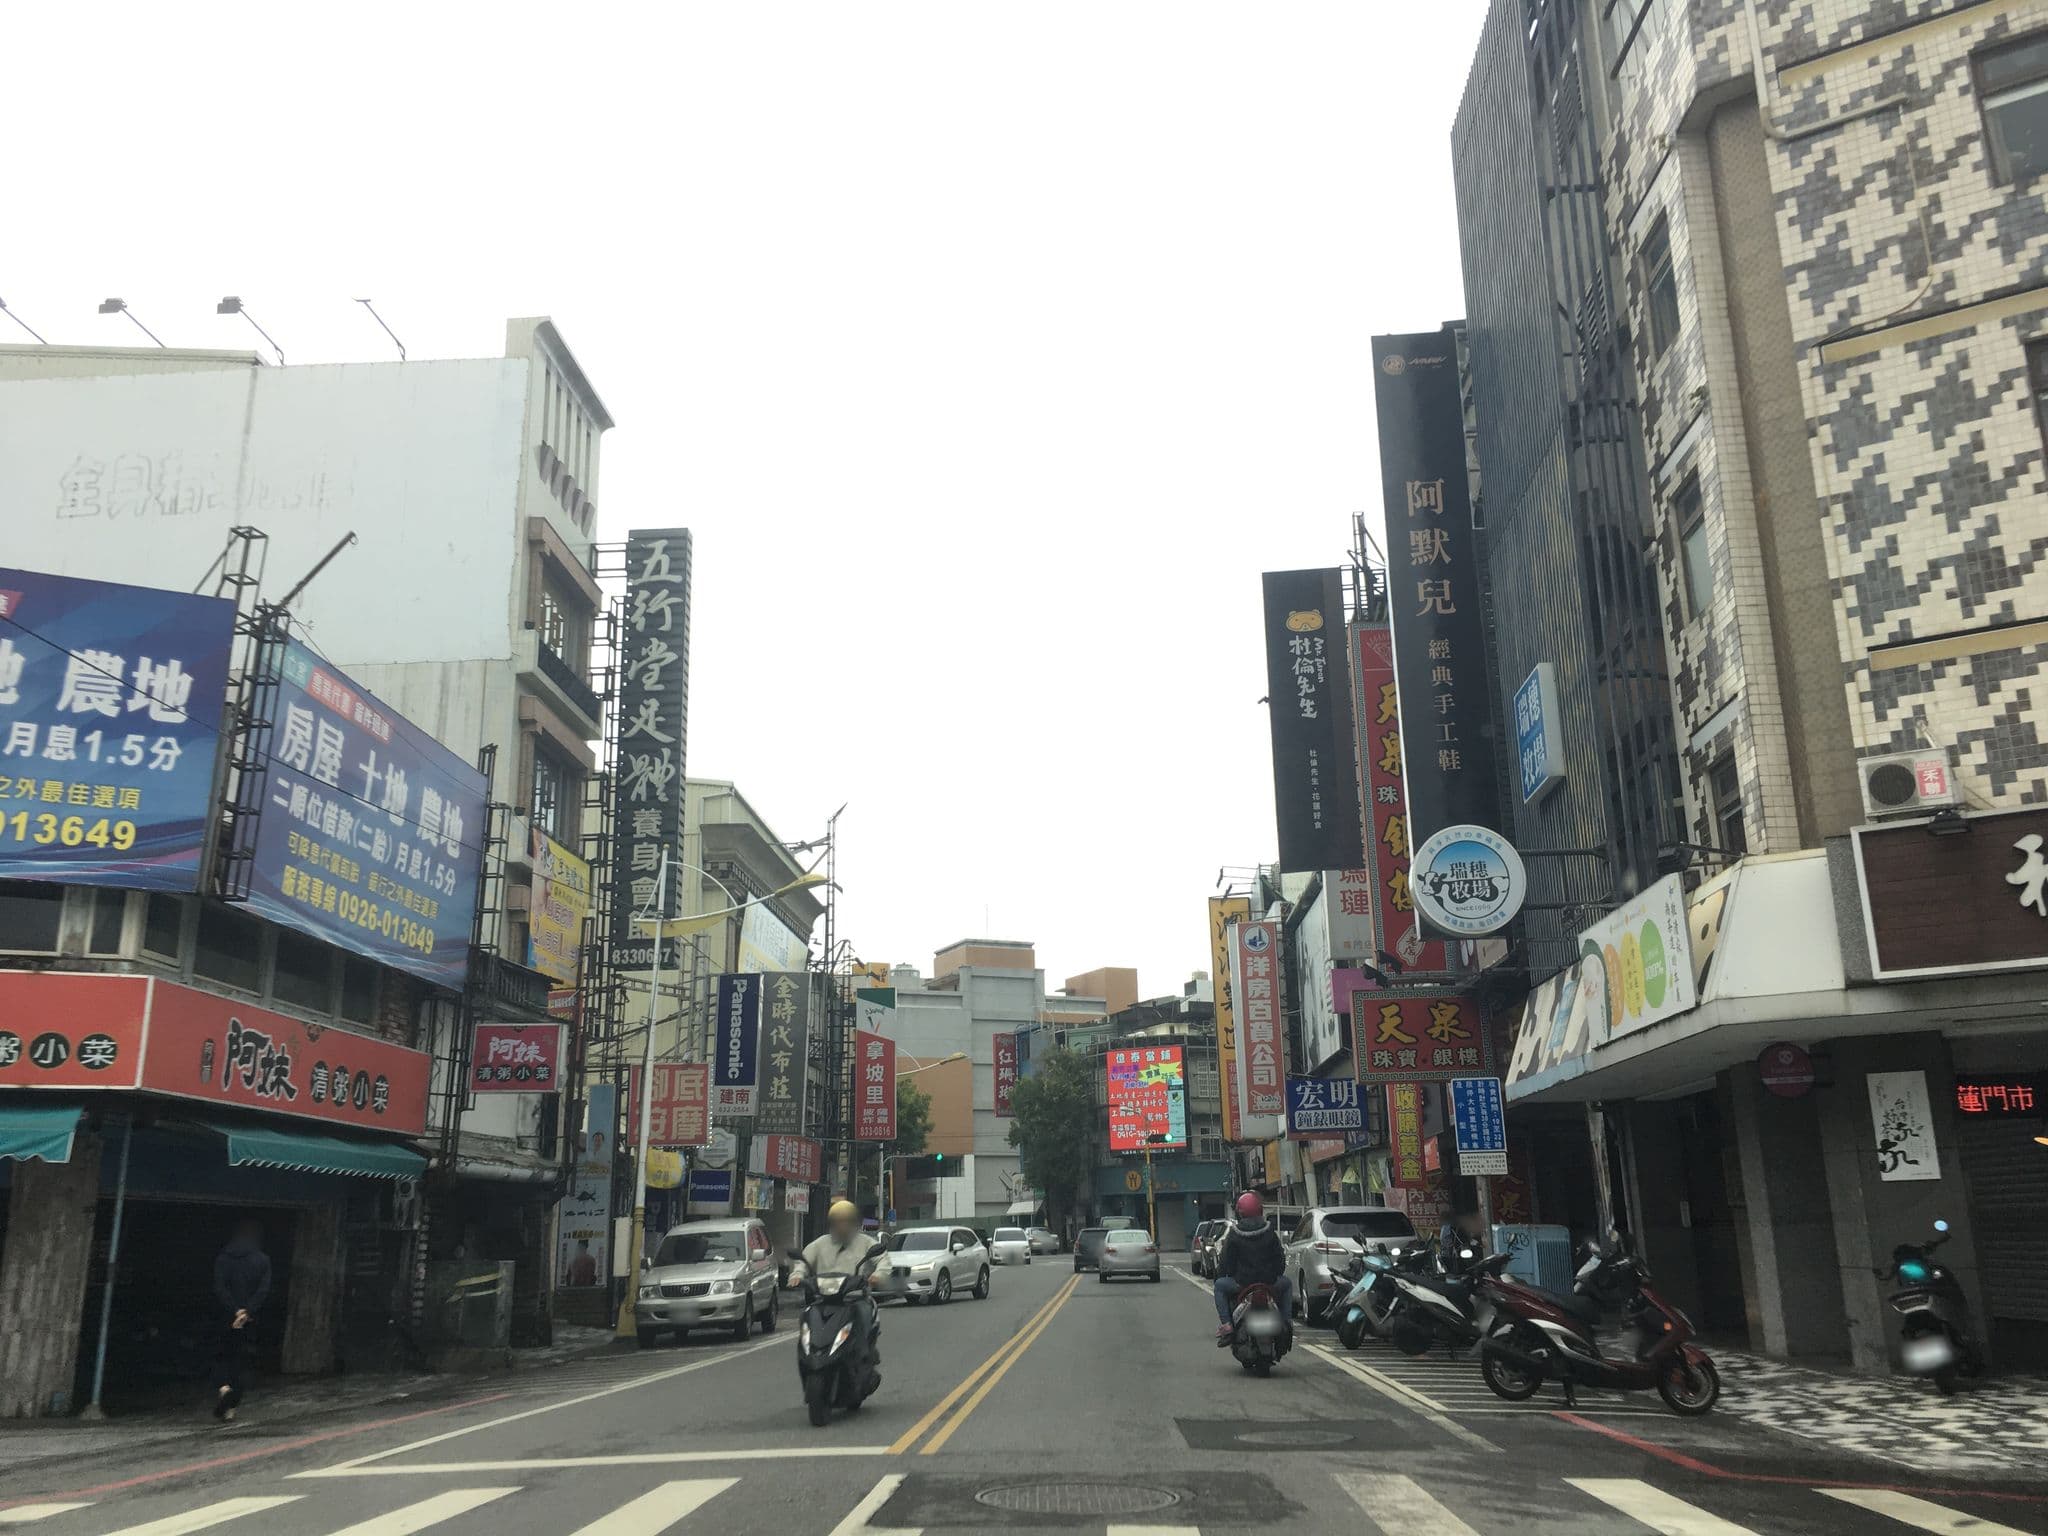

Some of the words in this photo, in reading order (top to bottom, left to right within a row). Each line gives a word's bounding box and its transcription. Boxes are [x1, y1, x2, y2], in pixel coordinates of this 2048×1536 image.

[1405, 479, 1456, 617] 阿默兒
[57, 649, 194, 724] 農地
[1289, 635, 1318, 719] 杜倫先生
[1428, 638, 1462, 771] 經典手工鞋
[5, 721, 183, 771] 月息1.5分
[278, 701, 345, 788] 房屋
[352, 749, 408, 827] 土地
[416, 785, 464, 859] 農地
[0, 810, 137, 852] 13649
[1449, 860, 1489, 879] 瑞穗
[1451, 880, 1491, 900] 牧場
[338, 890, 435, 955] 0926-013649
[612, 947, 672, 965] 833067
[728, 978, 748, 1080] Panasonic
[767, 974, 800, 1100] 金時代布莊
[1246, 955, 1277, 1087] 洋房百貨公司
[1375, 1002, 1472, 1043] 天泉
[222, 1016, 298, 1102] 阿妹
[478, 1066, 552, 1080] 清粥小菜
[486, 1036, 548, 1063] 阿妹
[865, 1040, 885, 1104] 拿坡里
[310, 1066, 389, 1110] 清粥小菜
[719, 1088, 750, 1104] 建南
[1295, 1080, 1358, 1109] 宏明
[1957, 1084, 2034, 1112] 蓮門市
[1395, 1082, 1421, 1180] 收購黃金
[690, 1183, 730, 1191] Panasonic
